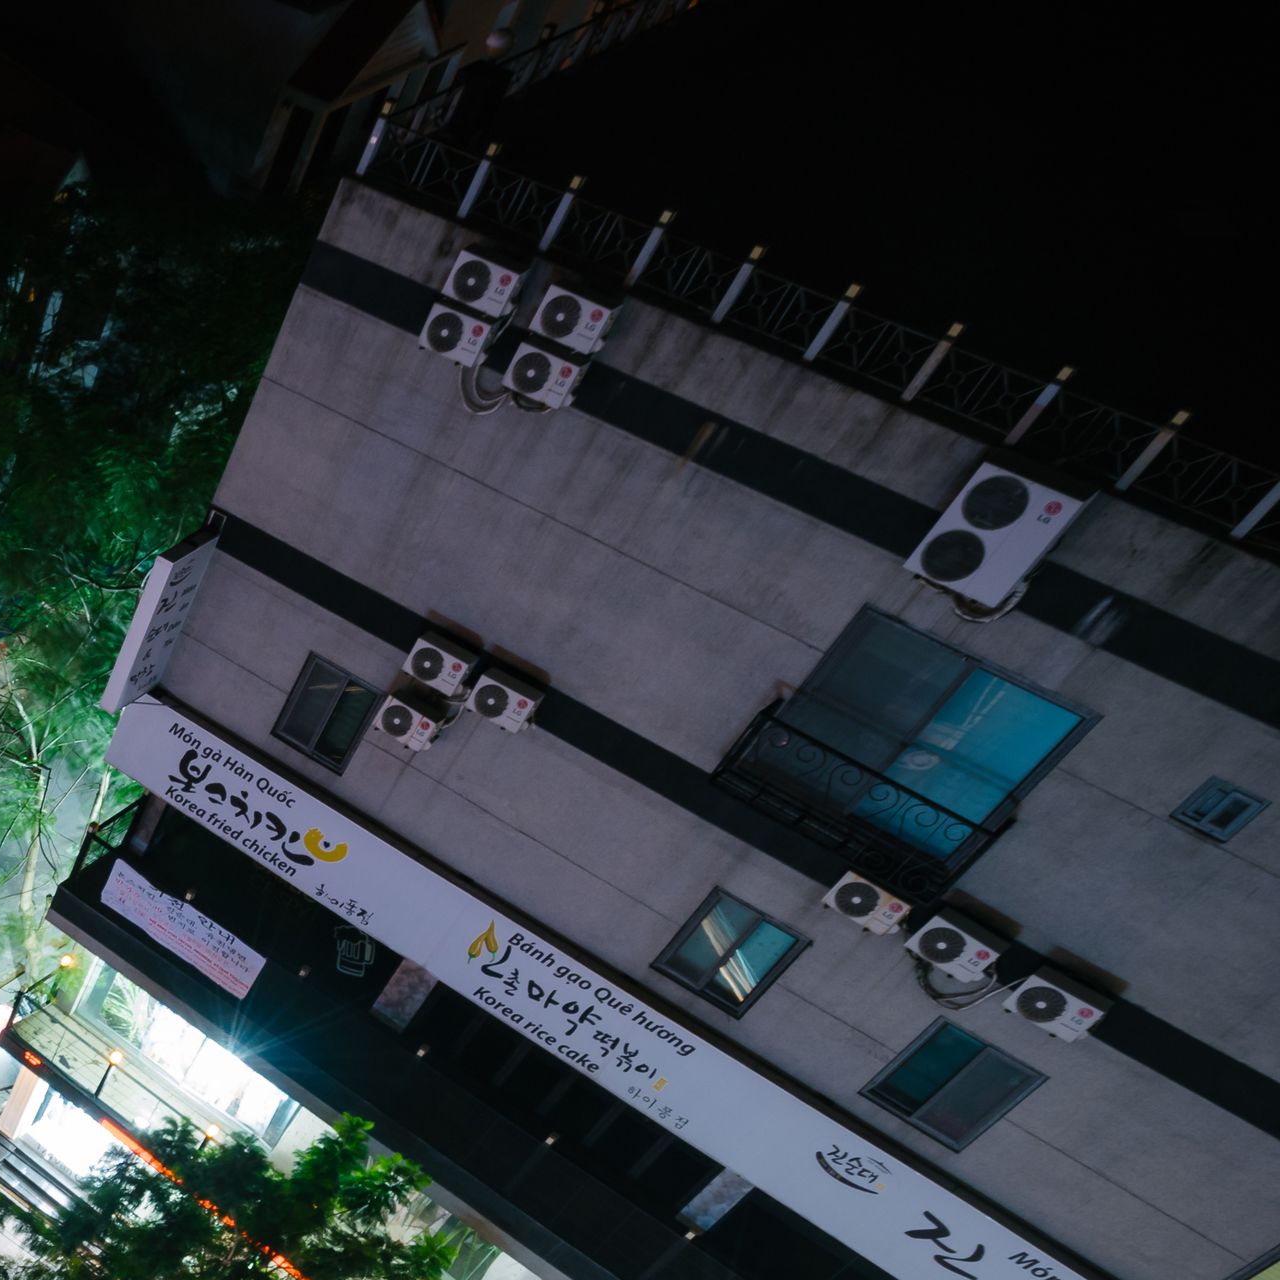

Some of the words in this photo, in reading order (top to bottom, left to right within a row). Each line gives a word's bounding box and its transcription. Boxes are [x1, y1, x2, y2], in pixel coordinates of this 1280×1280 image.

[168, 721, 202, 753] Món
[198, 744, 224, 765] gà
[224, 754, 255, 786] Hàn
[256, 776, 297, 808] Quốc
[165, 785, 208, 823] Korea
[205, 812, 242, 843] fried
[241, 833, 298, 878] chicken
[473, 986, 525, 1025] Korea
[524, 1021, 558, 1047] rice
[557, 1042, 601, 1073] cake
[507, 932, 555, 968] Bánh
[553, 965, 593, 991] gạo
[593, 986, 635, 1017] Quê
[632, 1011, 697, 1057] hương
